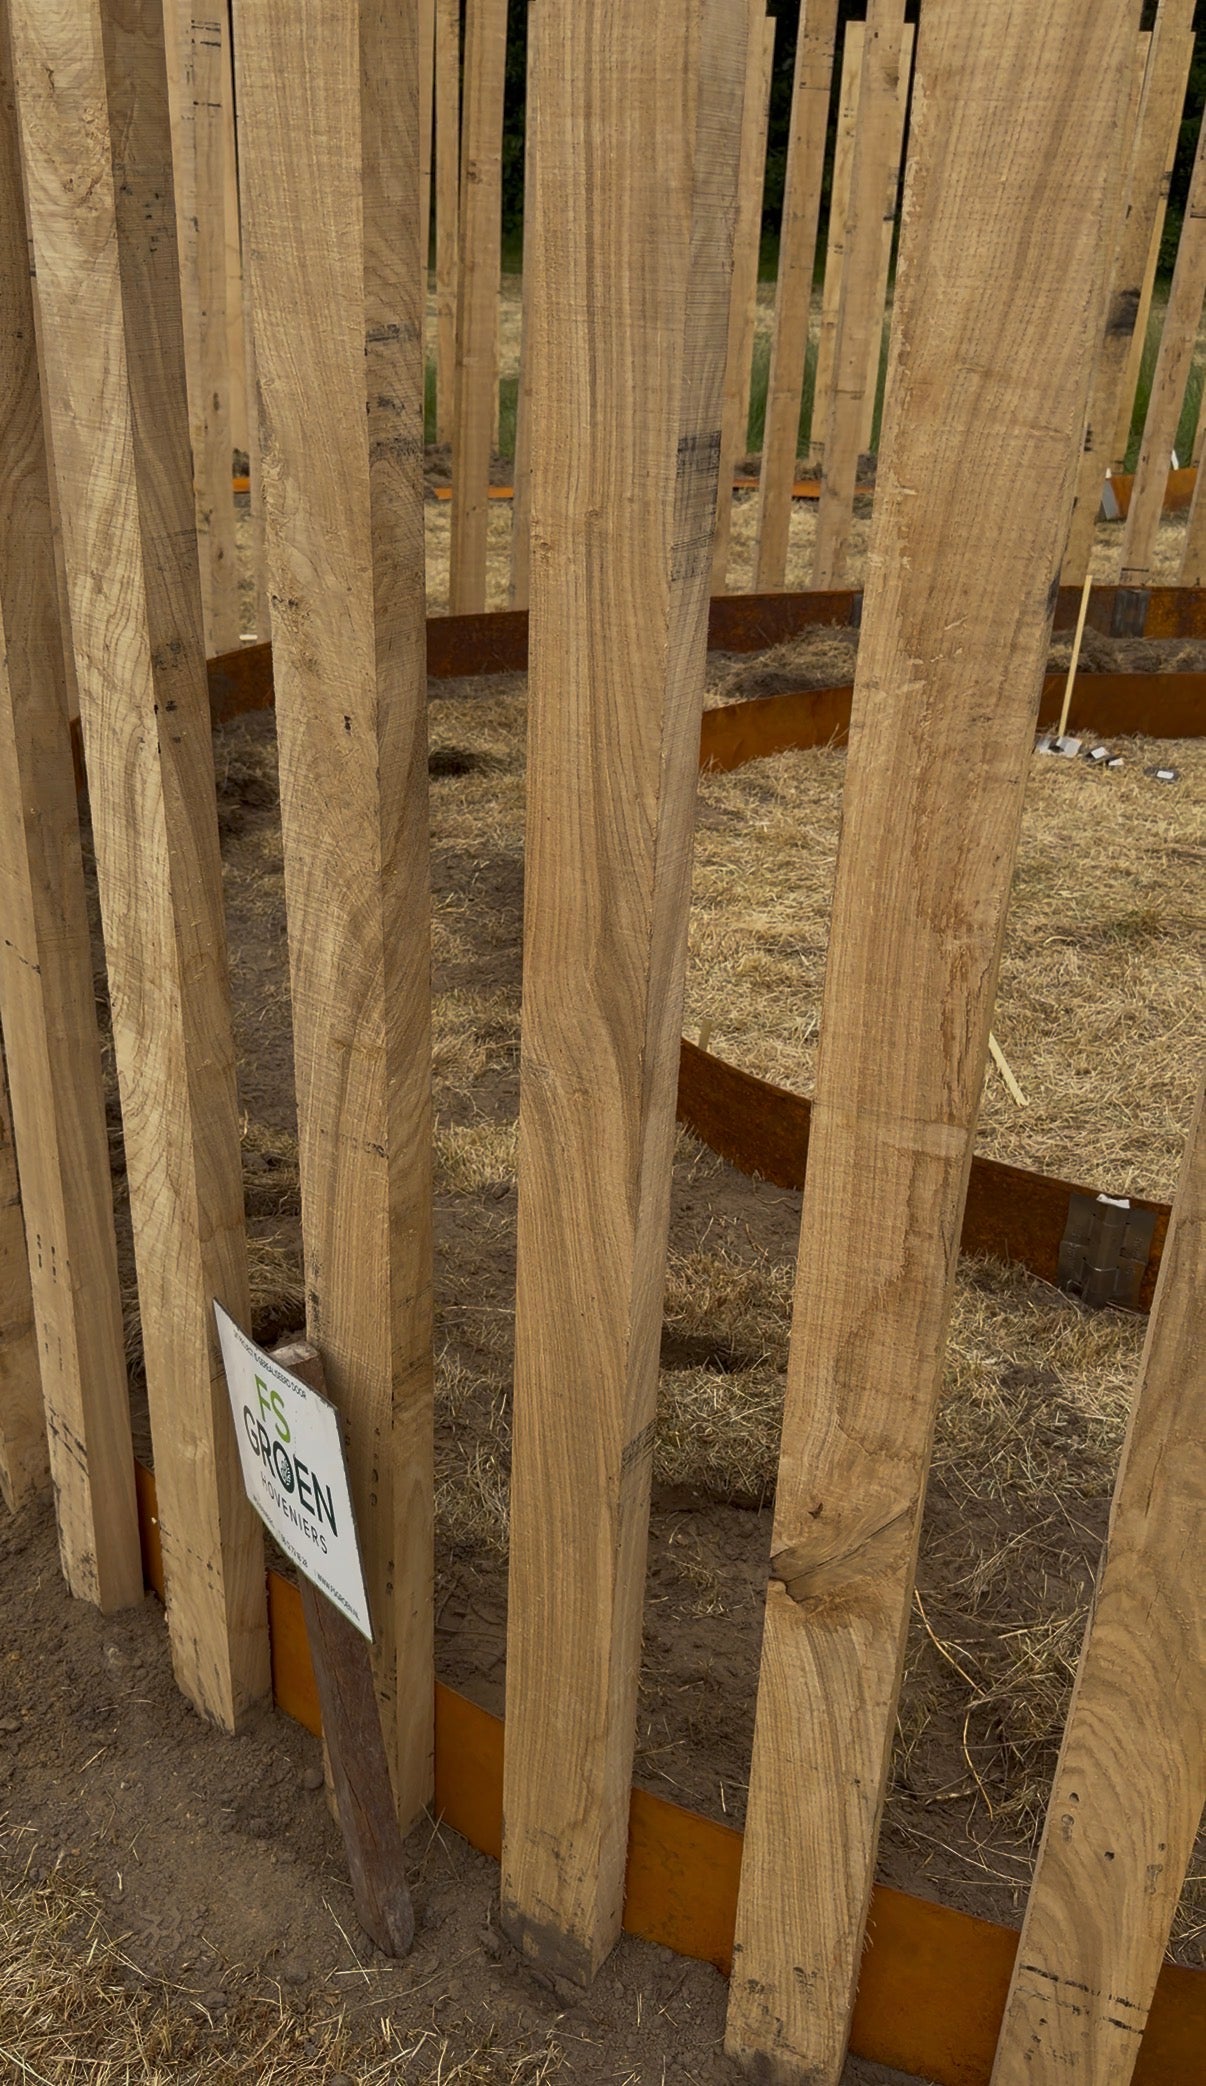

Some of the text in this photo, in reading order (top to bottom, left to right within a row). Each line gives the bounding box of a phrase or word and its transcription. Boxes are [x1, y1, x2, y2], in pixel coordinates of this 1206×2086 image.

[255, 1374, 291, 1443] FS
[243, 1405, 339, 1538] GROEN
[260, 1471, 328, 1555] HOVENIERS
